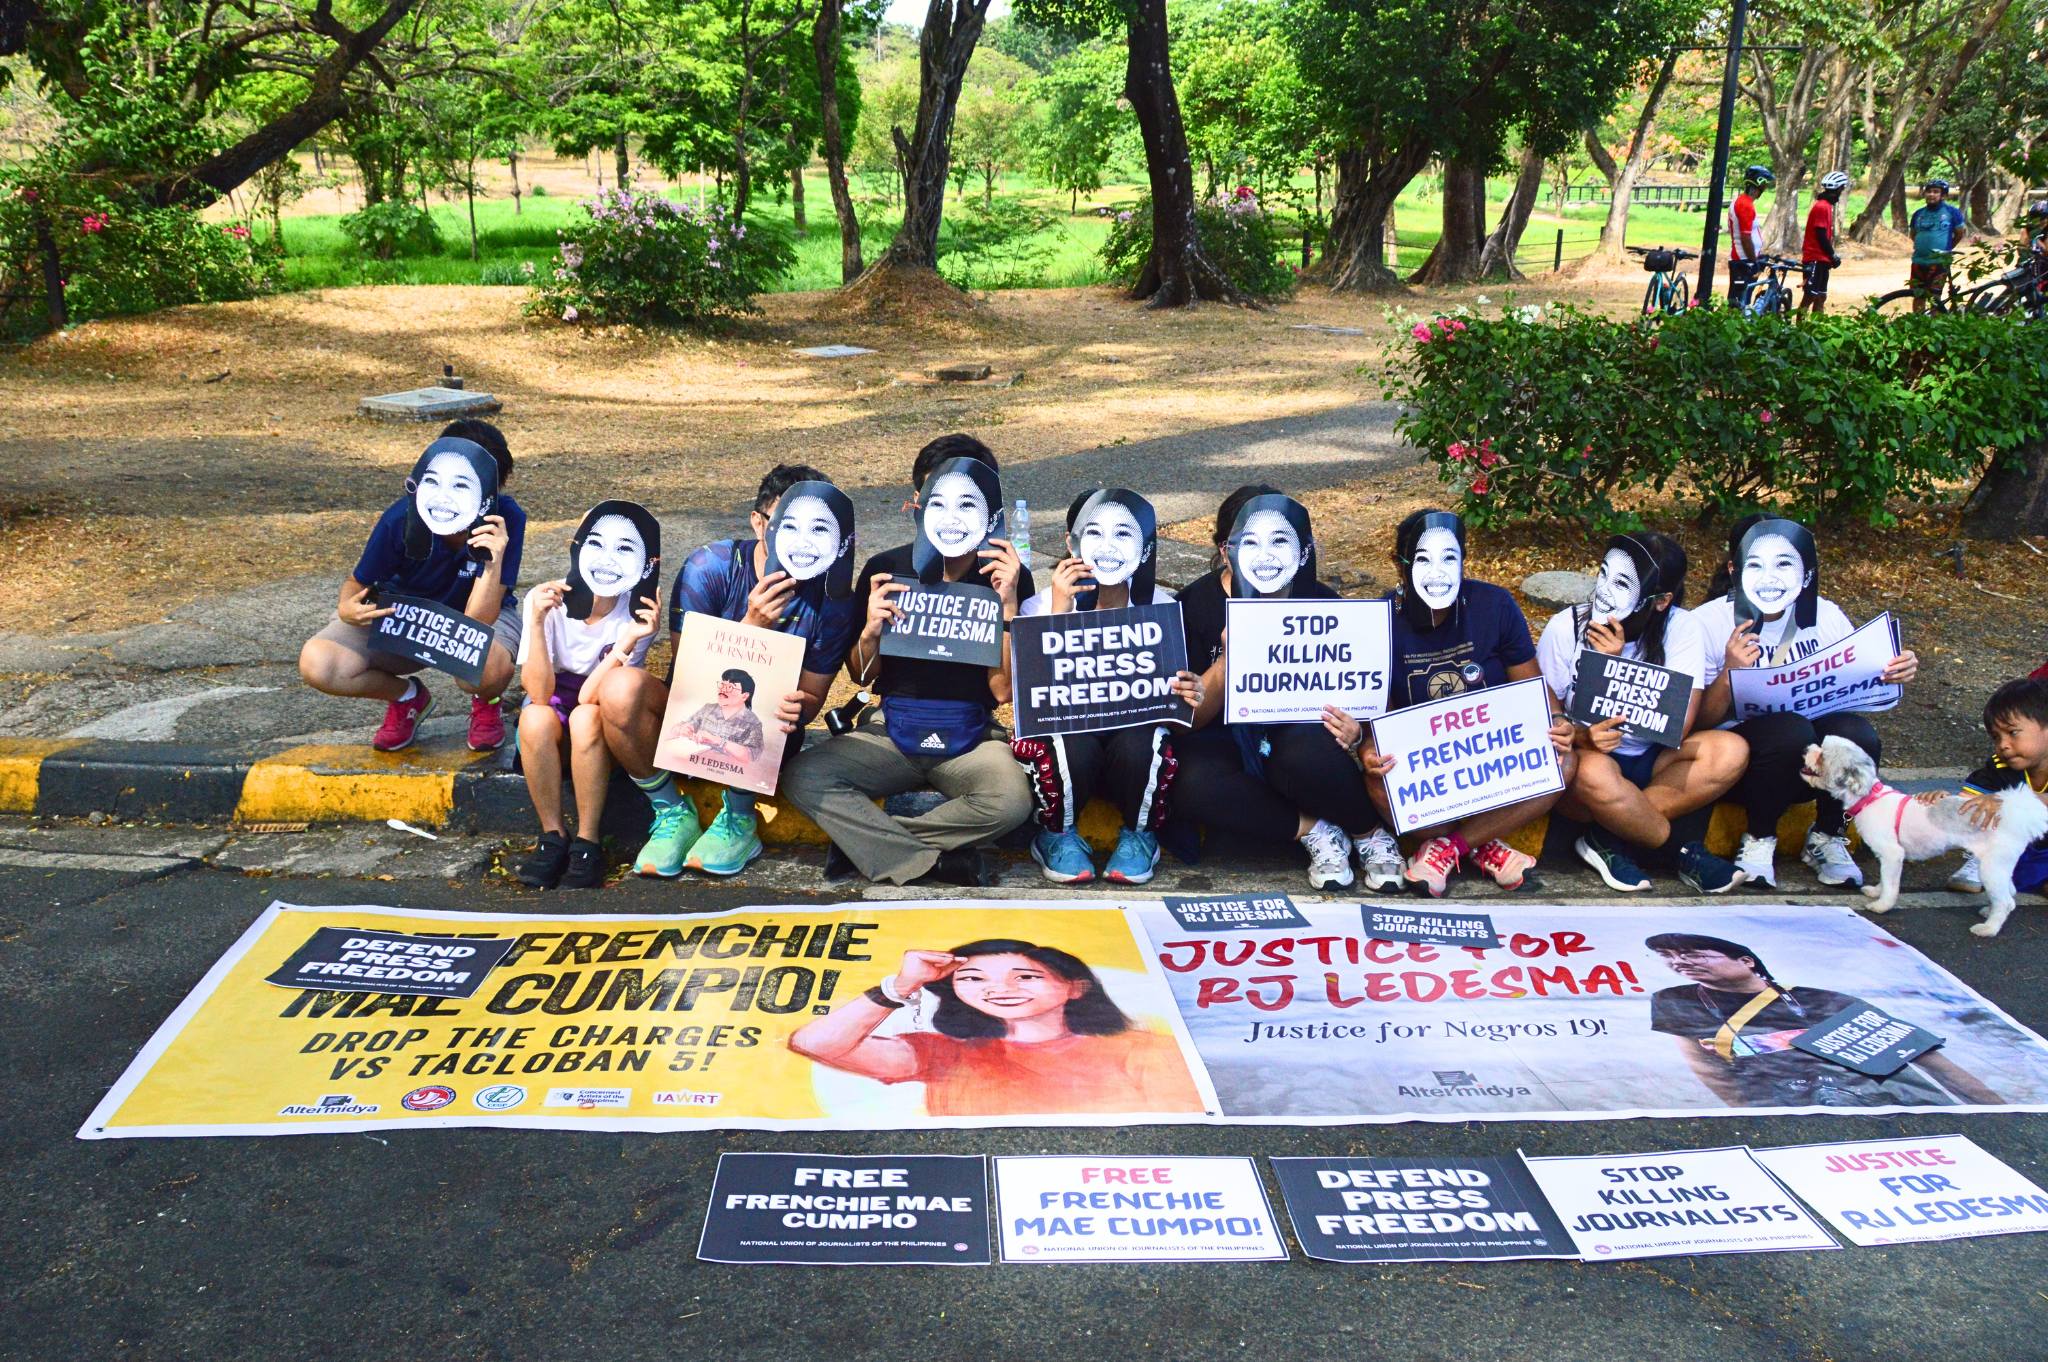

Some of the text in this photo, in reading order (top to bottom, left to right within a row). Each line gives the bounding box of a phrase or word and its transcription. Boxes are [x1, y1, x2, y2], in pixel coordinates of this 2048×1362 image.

[893, 592, 999, 622] JUSTICE FOR
[454, 623, 488, 649] FOR
[918, 616, 995, 644] LEDESMA
[1283, 616, 1339, 635] STOP
[380, 617, 405, 636] RJ
[406, 624, 481, 667] LEDESMA
[1042, 622, 1163, 654] DEFEND
[706, 641, 776, 666] JOURNALIST
[1268, 643, 1352, 664] KILLING
[1054, 651, 1156, 681] PRESS
[1603, 659, 1670, 691] DEFEND
[1766, 646, 1856, 686] JUSTICE
[1030, 676, 1179, 708] FREEDOM
[1236, 671, 1383, 693] JOURNALISTS
[1791, 675, 1836, 697] FOR
[1606, 680, 1661, 709] PRESS
[1086, 711, 1119, 719] JOURNALISTS
[1138, 704, 1167, 712] PHILIPPINES
[1429, 703, 1491, 736] FREE
[1590, 696, 1669, 733] FREEDOM
[1744, 703, 1772, 713] RJ
[920, 741, 945, 749] adidas
[1408, 723, 1525, 773] FRENCHIE
[689, 754, 699, 764] RJ
[701, 758, 744, 774] LEDESMA
[1398, 745, 1549, 807] MAE CUMPIO!
[1420, 808, 1445, 818] NATIONAL
[1447, 802, 1463, 810] UNION
[1471, 791, 1503, 804] JOURNALISTS
[1177, 898, 1288, 914] JUSTICE FOR
[1184, 910, 1295, 922] RJ LEDESMA
[1372, 914, 1485, 929] STOP KILLING
[1372, 922, 1489, 938] JOURNALISTS
[341, 937, 476, 958] DEFEND
[500, 923, 879, 967] FRENCHIE
[1159, 936, 1440, 973] JUSTICE
[339, 950, 454, 970] PRESS
[299, 962, 472, 984] FREEDOM
[485, 966, 842, 1016] CUMPIO!
[1196, 960, 1645, 1011] RJ LEDESMA!
[299, 1024, 762, 1053] DROP THE CHARGES
[1244, 1018, 1608, 1043] Justice for Negros 19!
[1811, 1023, 1868, 1055] JUSTICE
[1851, 1010, 1889, 1031] FOR
[1837, 1049, 1869, 1065] RJ
[1853, 1021, 1917, 1056] LEDESMA
[329, 1050, 716, 1080] VS TACLOBAN 5!
[656, 1092, 718, 1104] IAWRT
[1398, 1083, 1532, 1099] Altermidya
[282, 1104, 379, 1114] Altermidya
[1825, 1149, 1956, 1172] JUSTICE
[794, 1168, 909, 1188] FREE
[1081, 1167, 1172, 1184] FREE
[1316, 1169, 1490, 1189] DEFEND
[1601, 1165, 1684, 1183] STOP
[1879, 1173, 1961, 1196] FOR
[725, 1194, 972, 1212] FRENCHIE MAE
[1039, 1191, 1225, 1210] FRENCHIE
[1341, 1190, 1490, 1211] PRESS
[1597, 1185, 1730, 1206] KILLING
[782, 1213, 917, 1229] CUMPIO
[1014, 1216, 1264, 1237] MAE CUMPIO!
[1315, 1211, 1541, 1235] FREEDOM
[1572, 1204, 1798, 1232] JOURNALISTS
[1840, 1206, 1896, 1229] RJ
[1614, 1243, 1654, 1251] NATIONAL
[1694, 1237, 1742, 1245] JOURNALISTS
